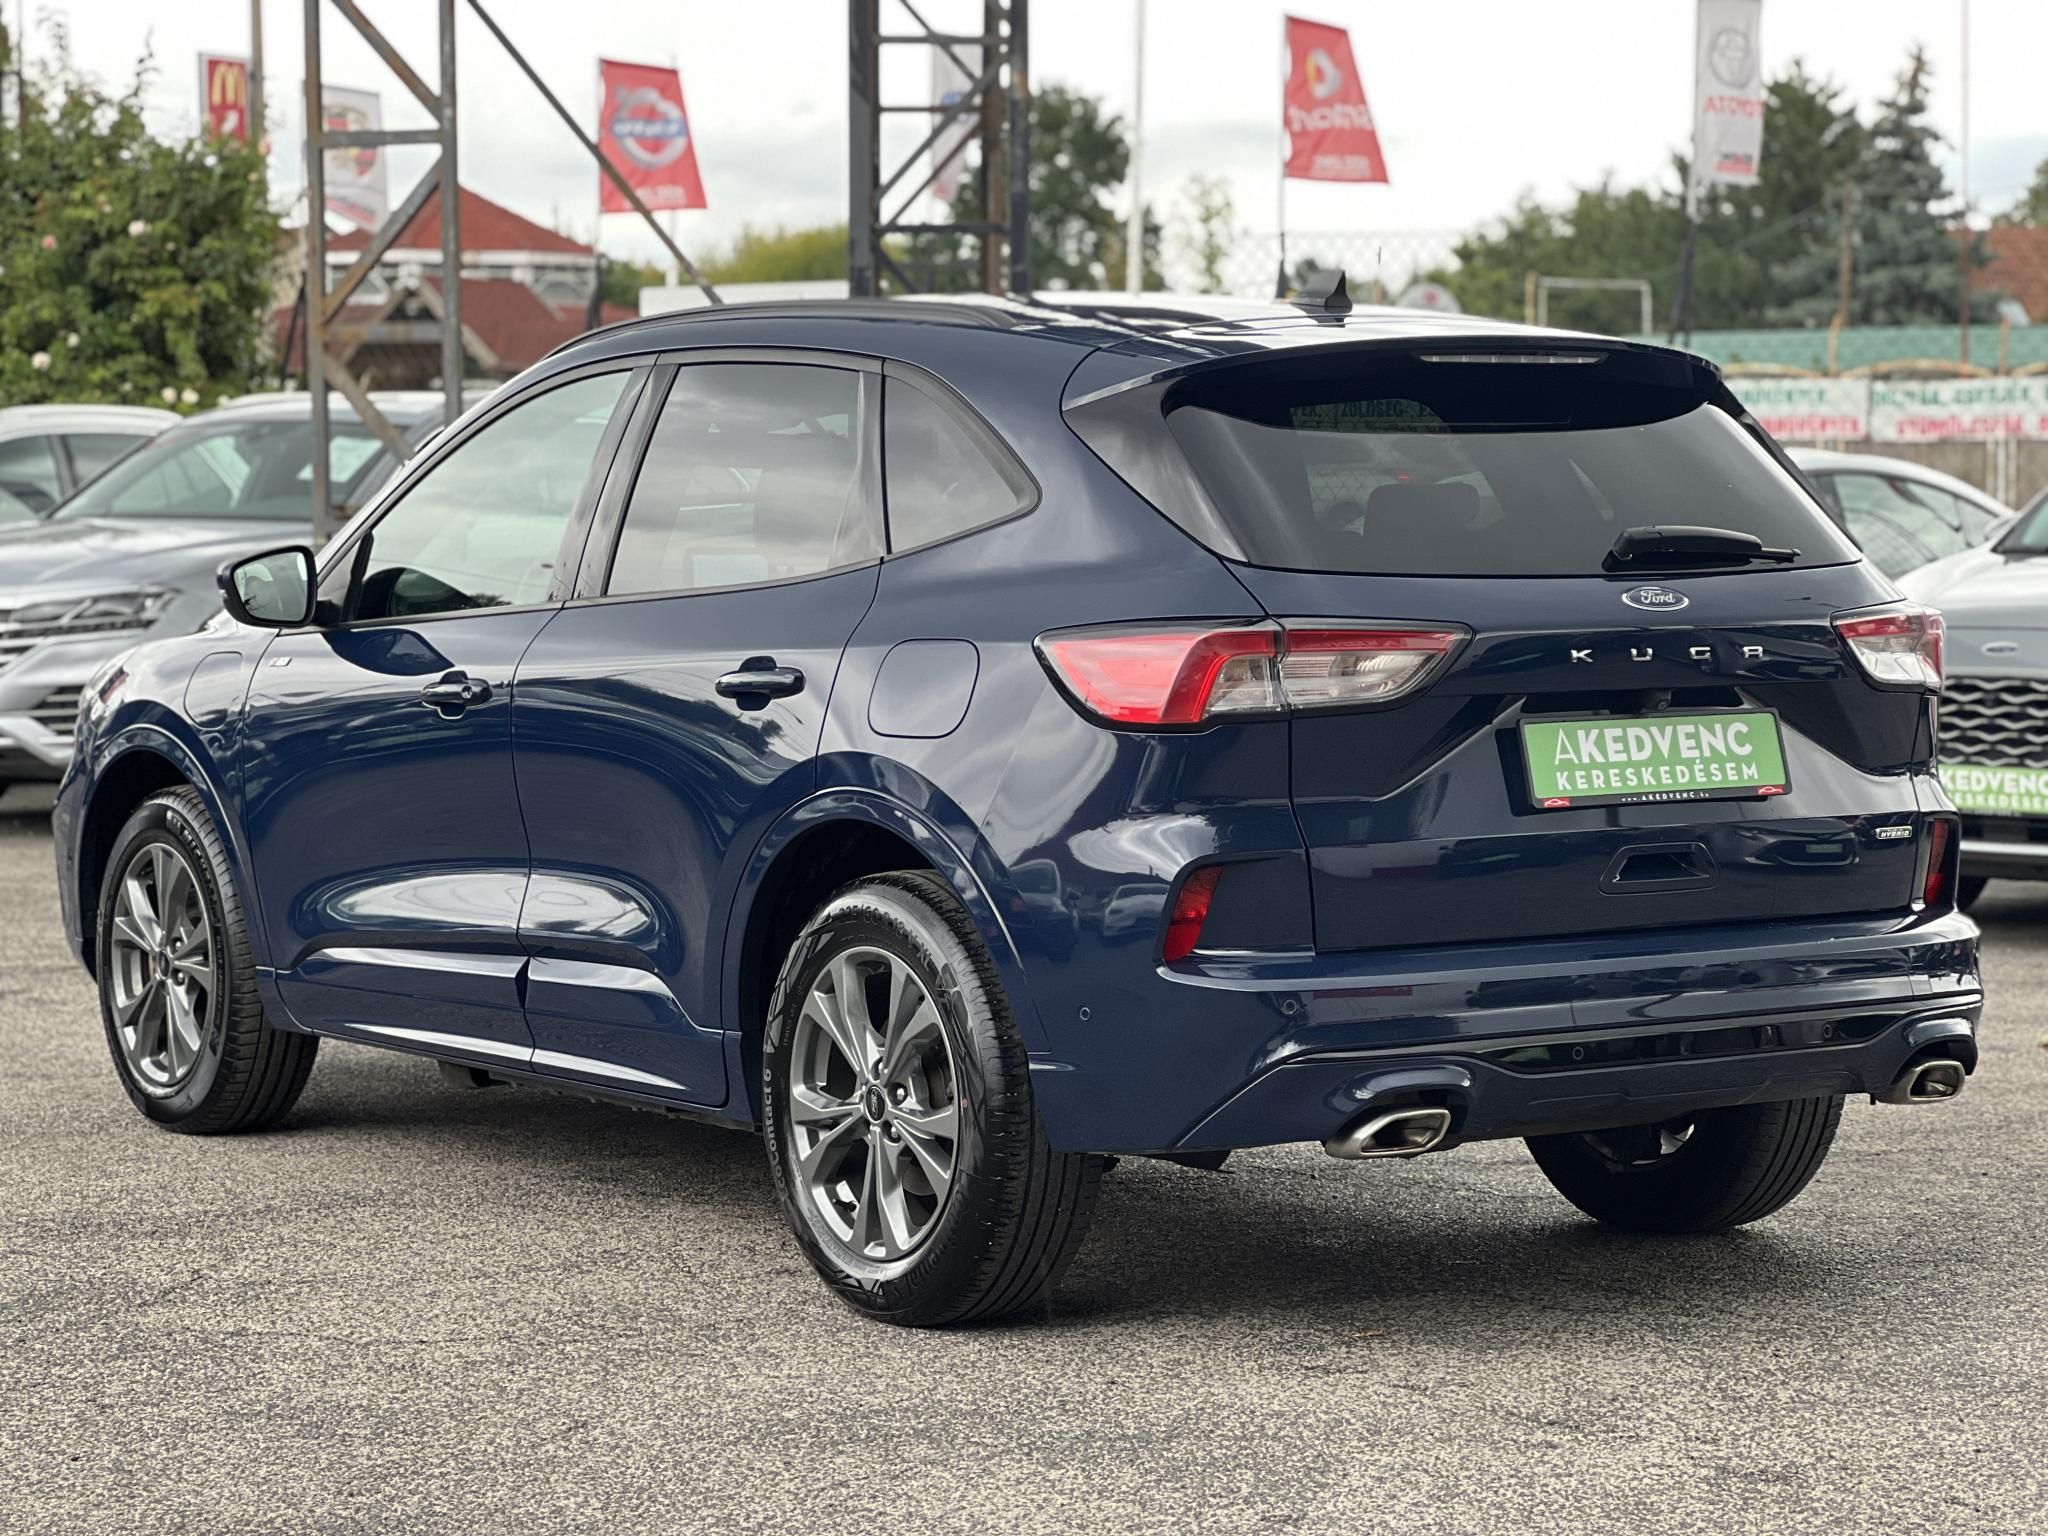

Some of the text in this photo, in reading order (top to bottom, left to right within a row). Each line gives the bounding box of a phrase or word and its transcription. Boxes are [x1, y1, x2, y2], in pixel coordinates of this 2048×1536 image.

[1641, 590, 1676, 603] Ford
[1571, 645, 1764, 662] KUGA
[1556, 759, 1759, 791] KERESKEDÉSEM
[1880, 830, 1910, 838] HYBRID
